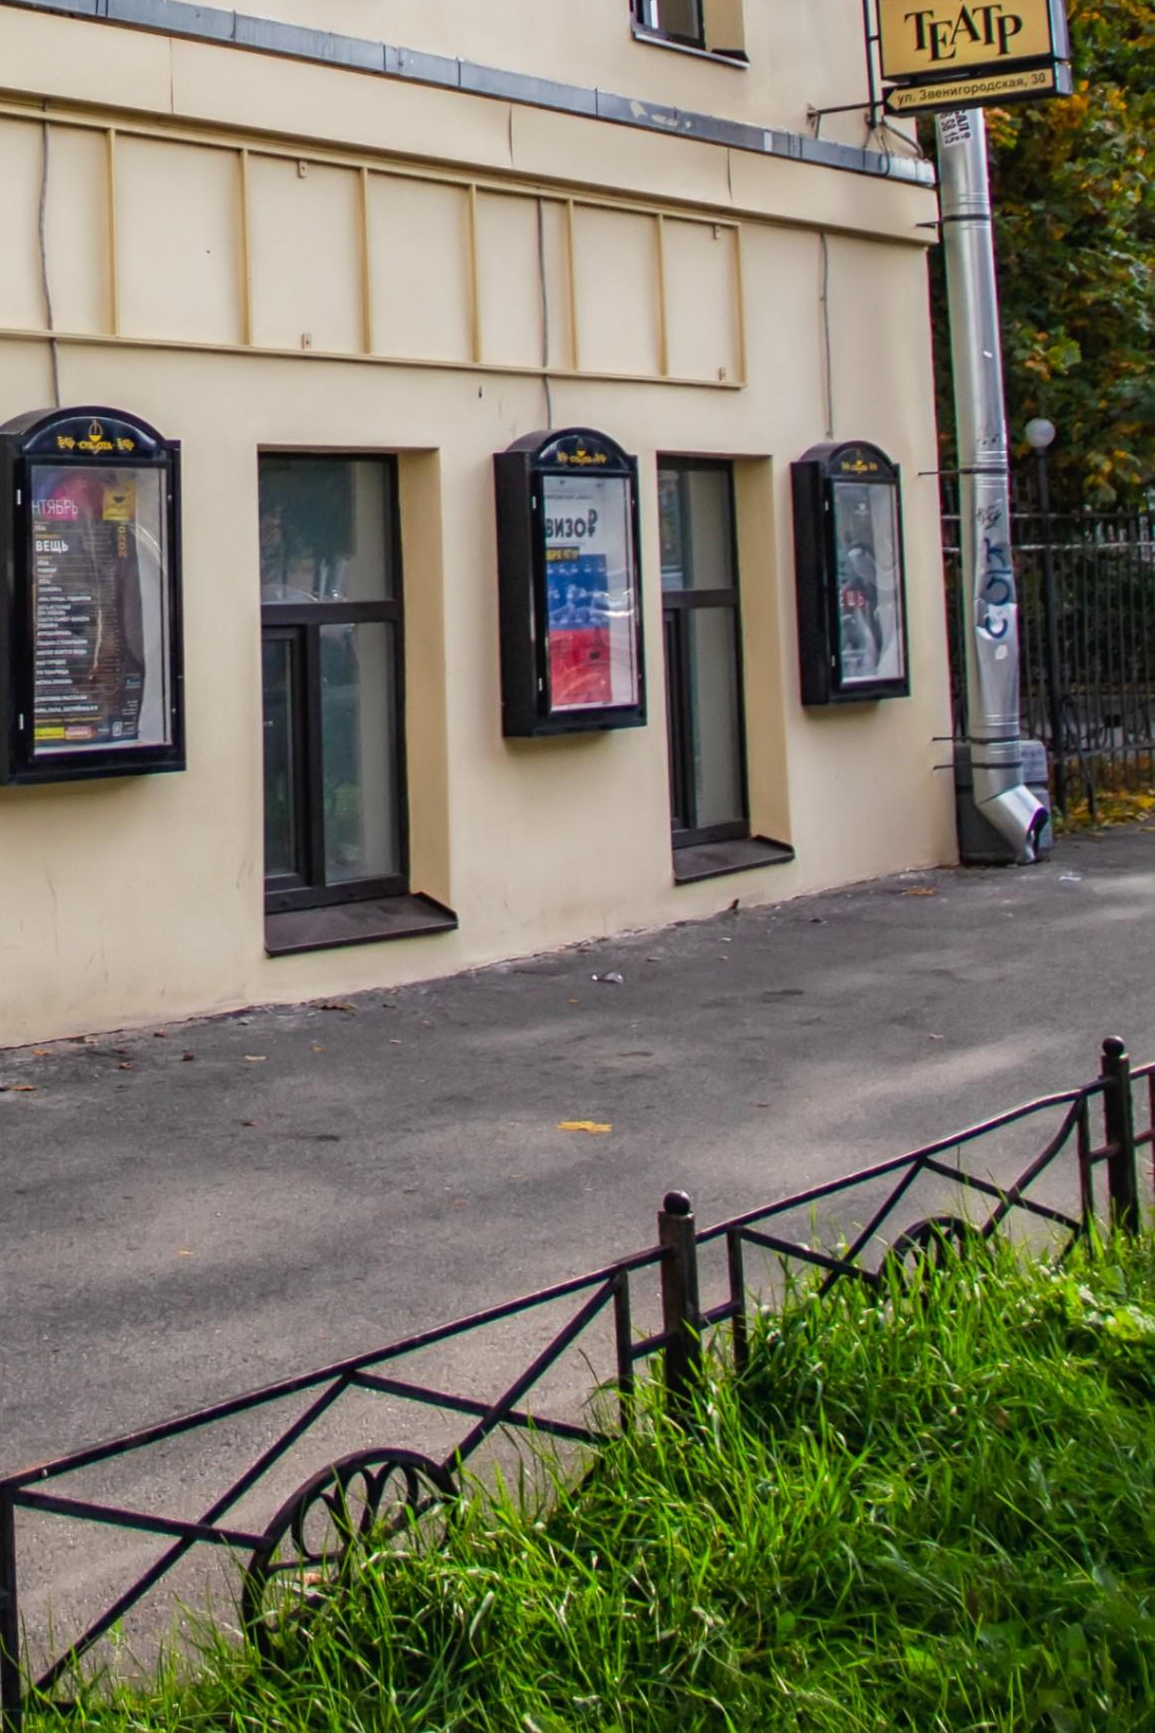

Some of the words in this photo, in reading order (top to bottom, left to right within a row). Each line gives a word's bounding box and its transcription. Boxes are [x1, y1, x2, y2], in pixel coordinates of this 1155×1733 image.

[904, 4, 1022, 61] ТЕАТР
[897, 93, 916, 106] ул.
[919, 78, 1028, 100] Звенигородская,
[1031, 72, 1046, 85] 30
[36, 540, 69, 554] ВЕЩЬ
